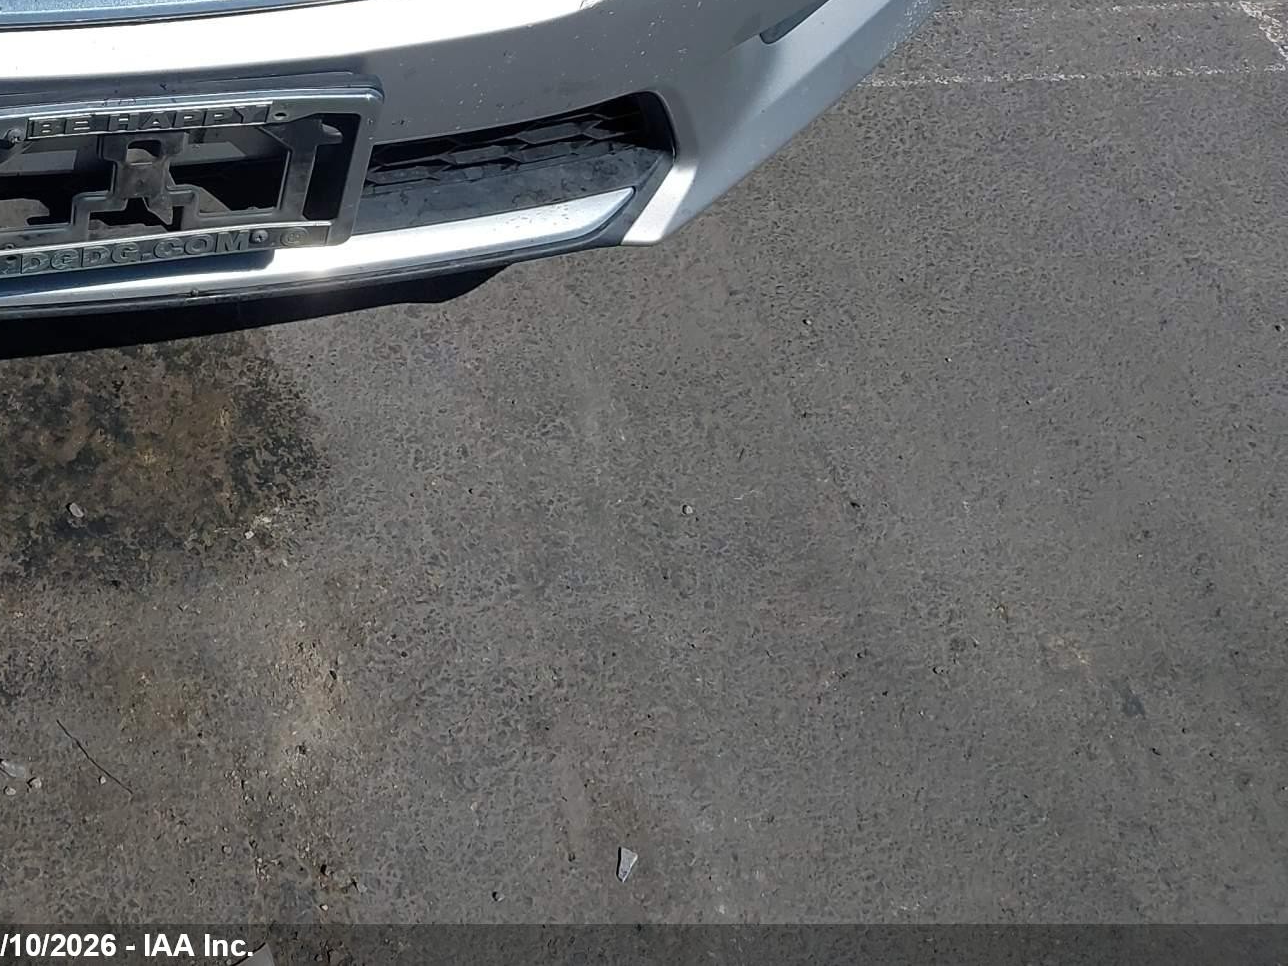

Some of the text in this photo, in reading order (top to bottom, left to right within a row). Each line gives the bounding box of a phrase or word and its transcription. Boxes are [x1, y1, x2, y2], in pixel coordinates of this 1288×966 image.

[32, 104, 268, 137] BE HAPPY
[21, 230, 251, 274] DGDG.COM
